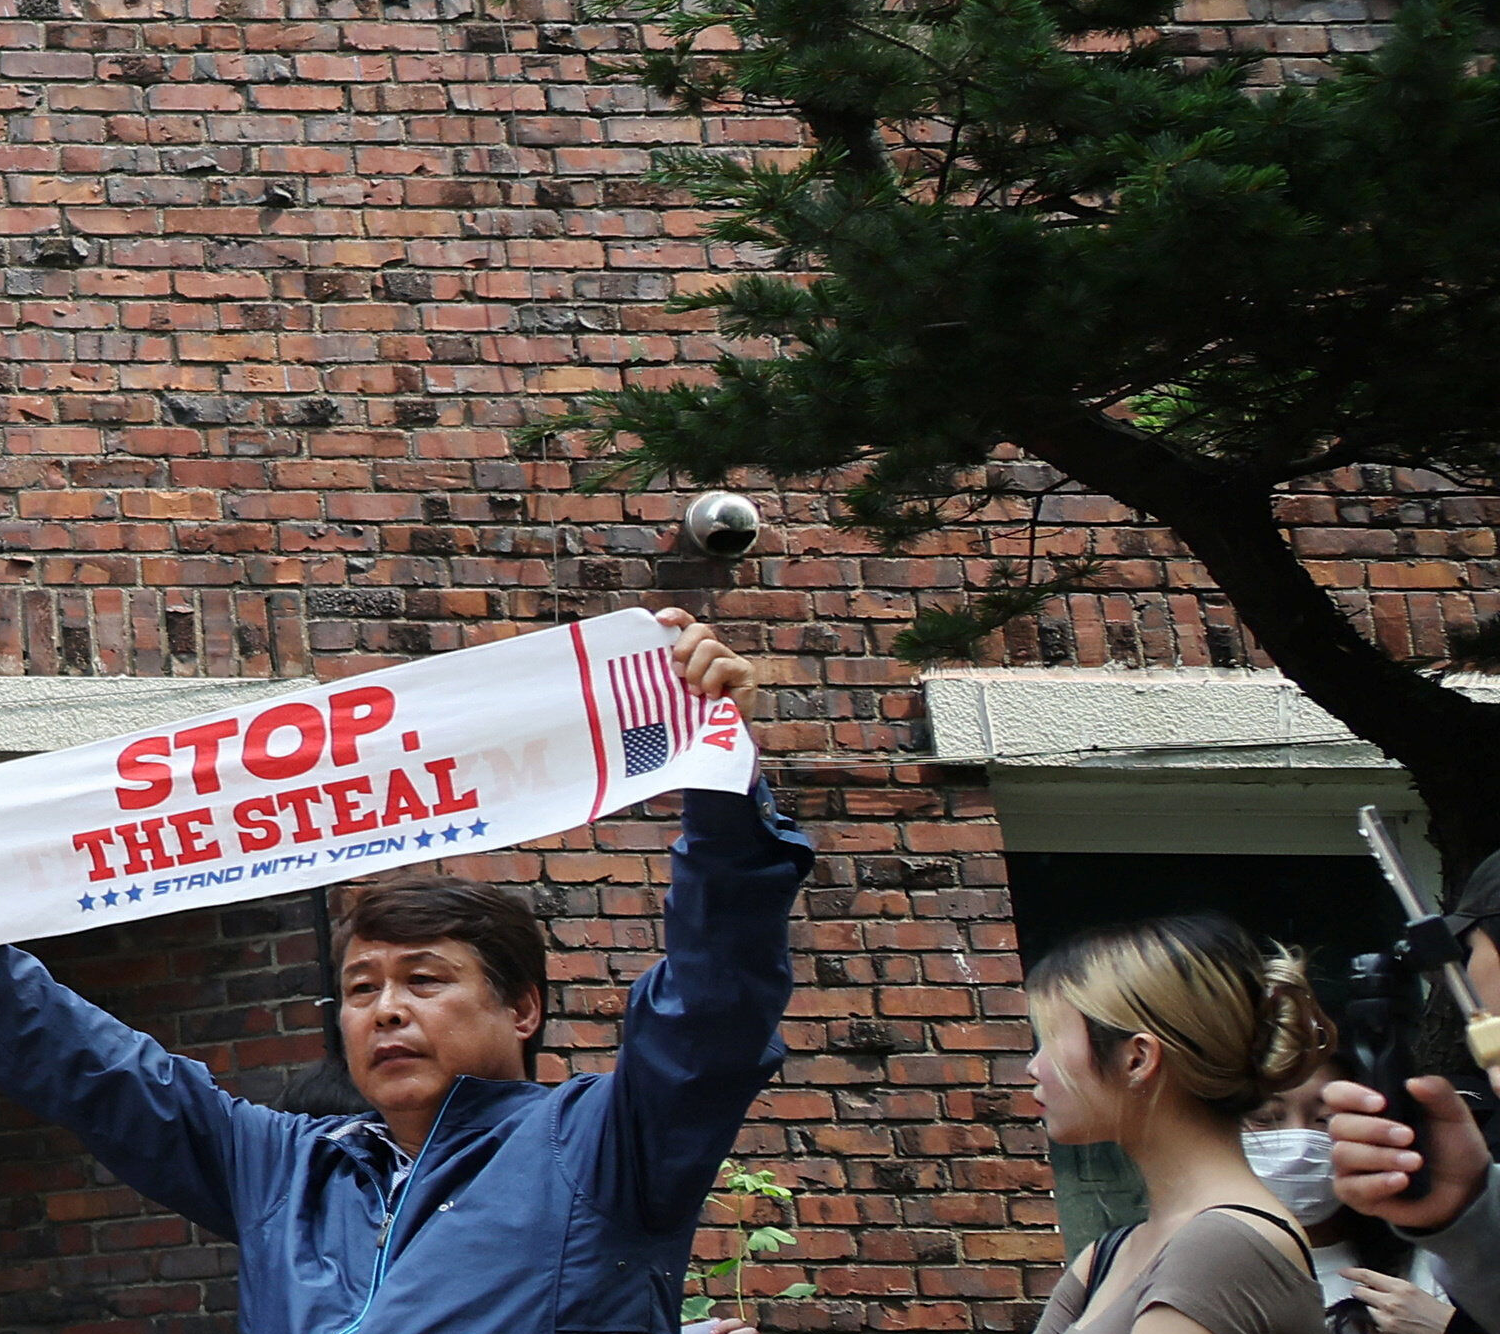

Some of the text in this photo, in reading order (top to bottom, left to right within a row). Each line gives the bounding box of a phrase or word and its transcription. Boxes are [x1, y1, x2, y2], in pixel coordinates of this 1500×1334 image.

[115, 686, 421, 810] STOP.
[72, 757, 479, 882] THE STEAL
[153, 835, 406, 896] STAND WITH YOON
